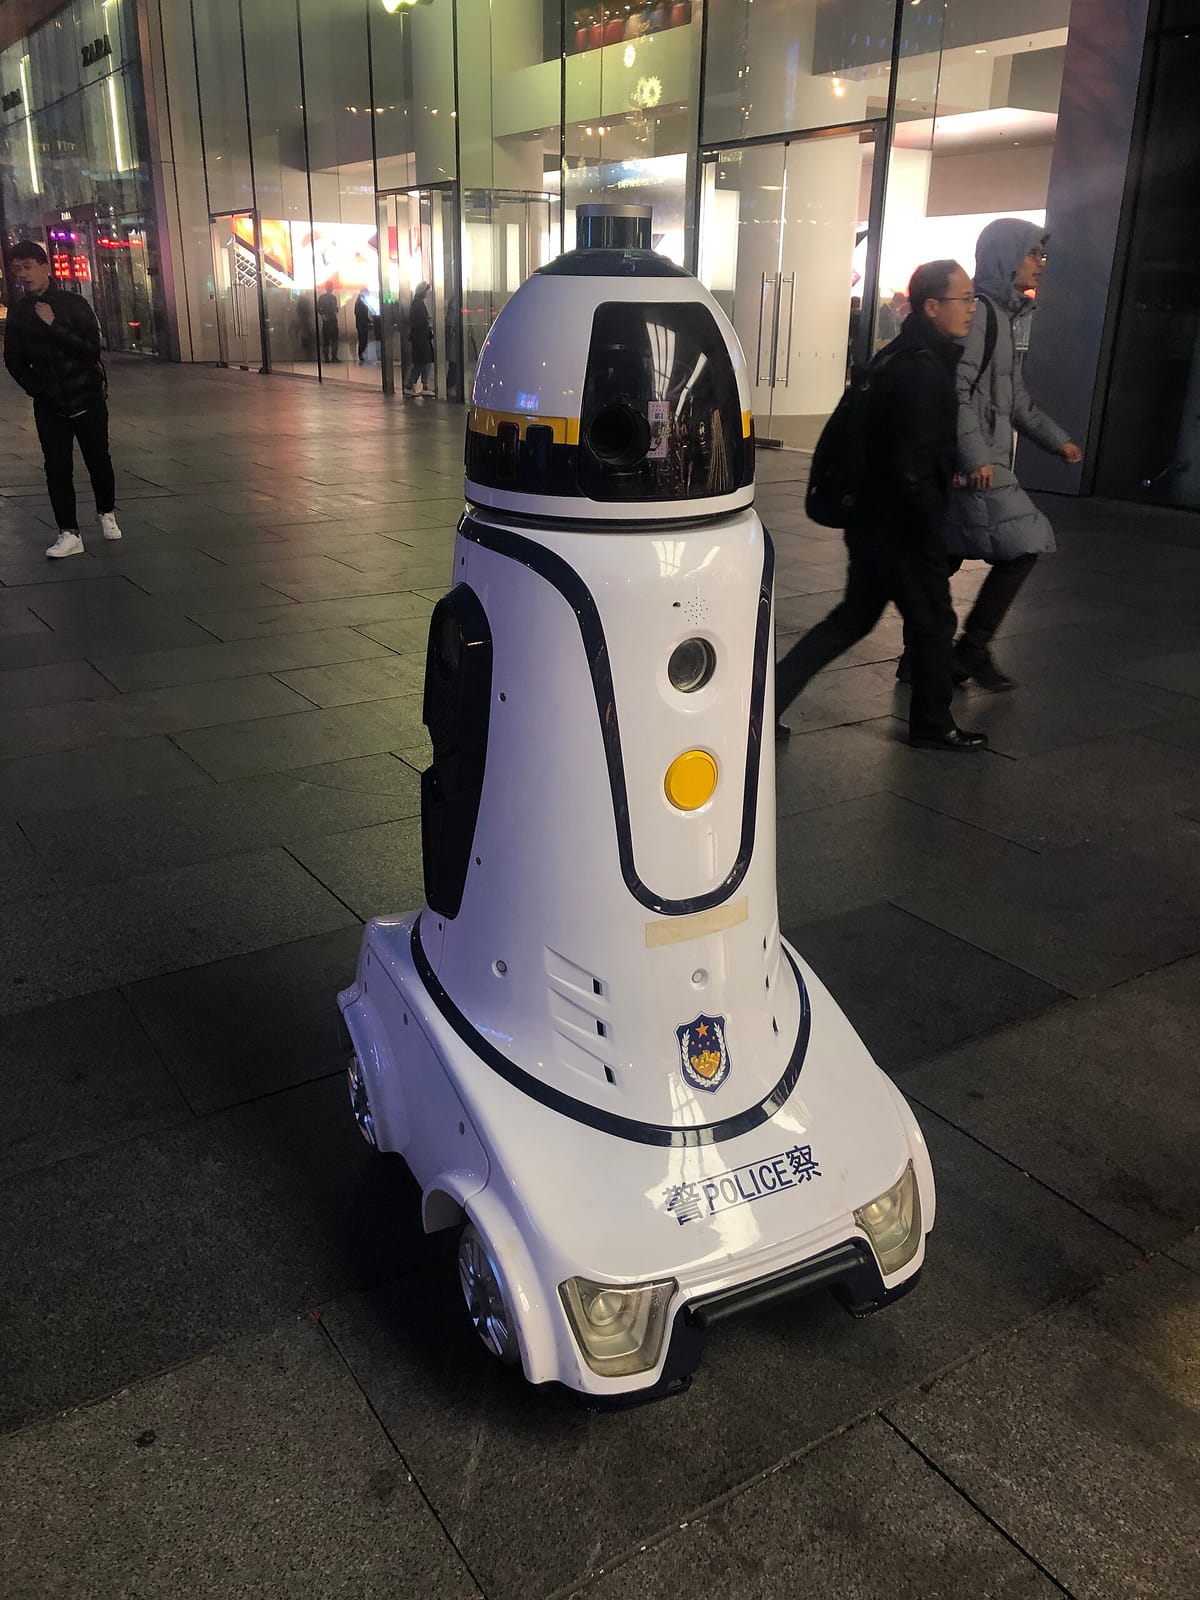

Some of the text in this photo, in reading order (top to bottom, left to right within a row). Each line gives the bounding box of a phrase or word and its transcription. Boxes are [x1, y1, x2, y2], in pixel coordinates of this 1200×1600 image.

[81, 34, 112, 67] ZARA
[662, 1145, 822, 1226] 警 POLICE 察
